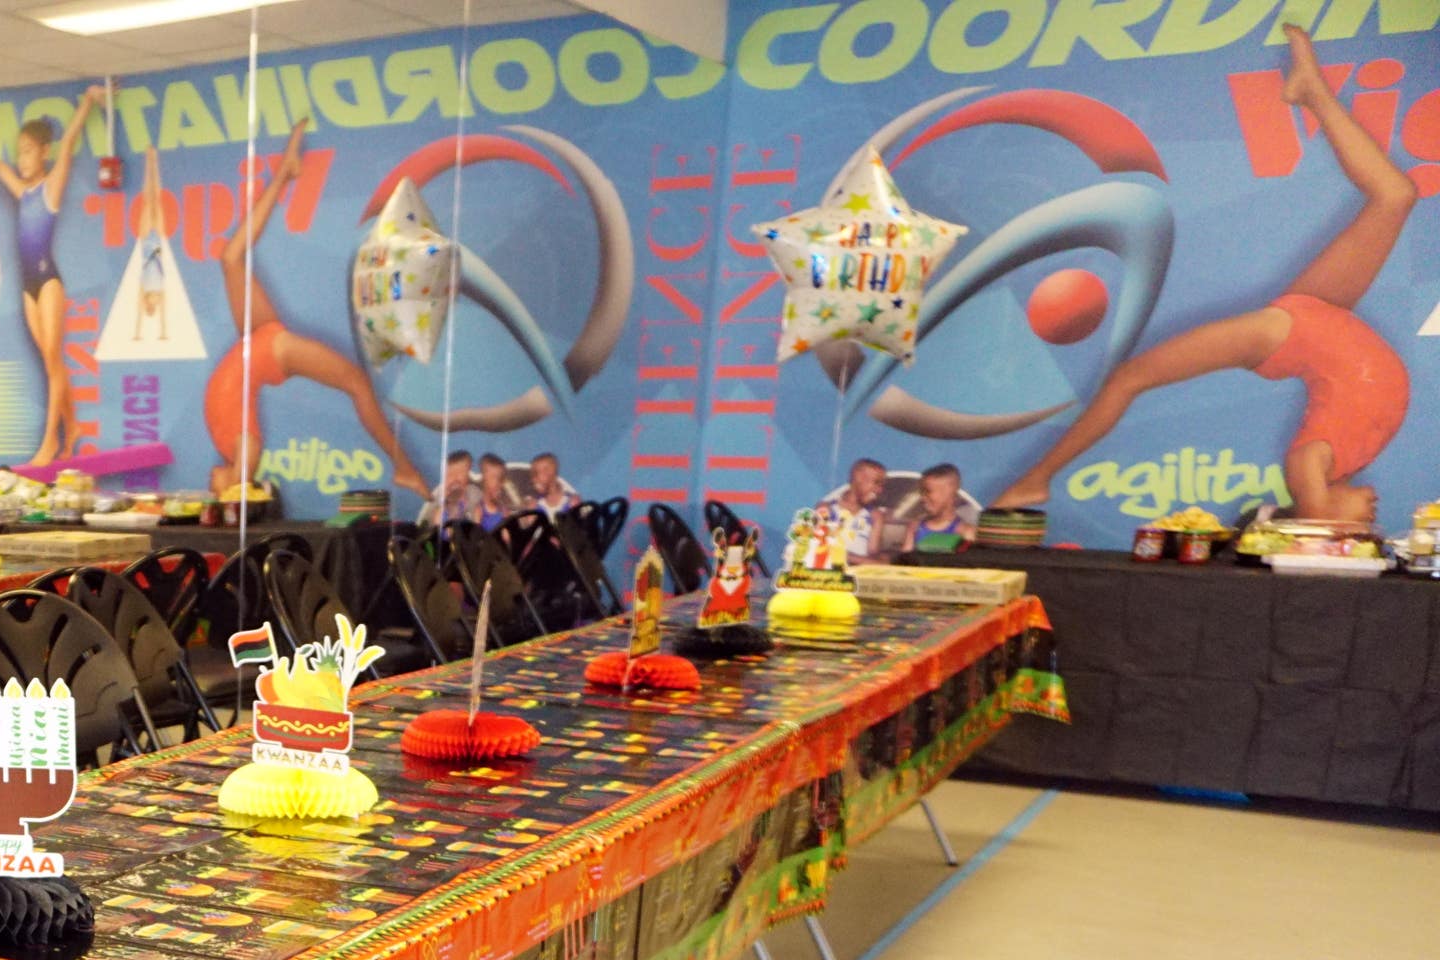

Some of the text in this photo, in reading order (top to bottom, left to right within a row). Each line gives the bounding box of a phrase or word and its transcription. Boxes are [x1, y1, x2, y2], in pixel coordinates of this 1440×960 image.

[839, 222, 912, 248] HAPPY
[811, 253, 932, 293] BIRTHDAY
[1067, 447, 1294, 519] agility
[53, 706, 70, 766] Imani
[256, 746, 343, 771] KWANZAA
